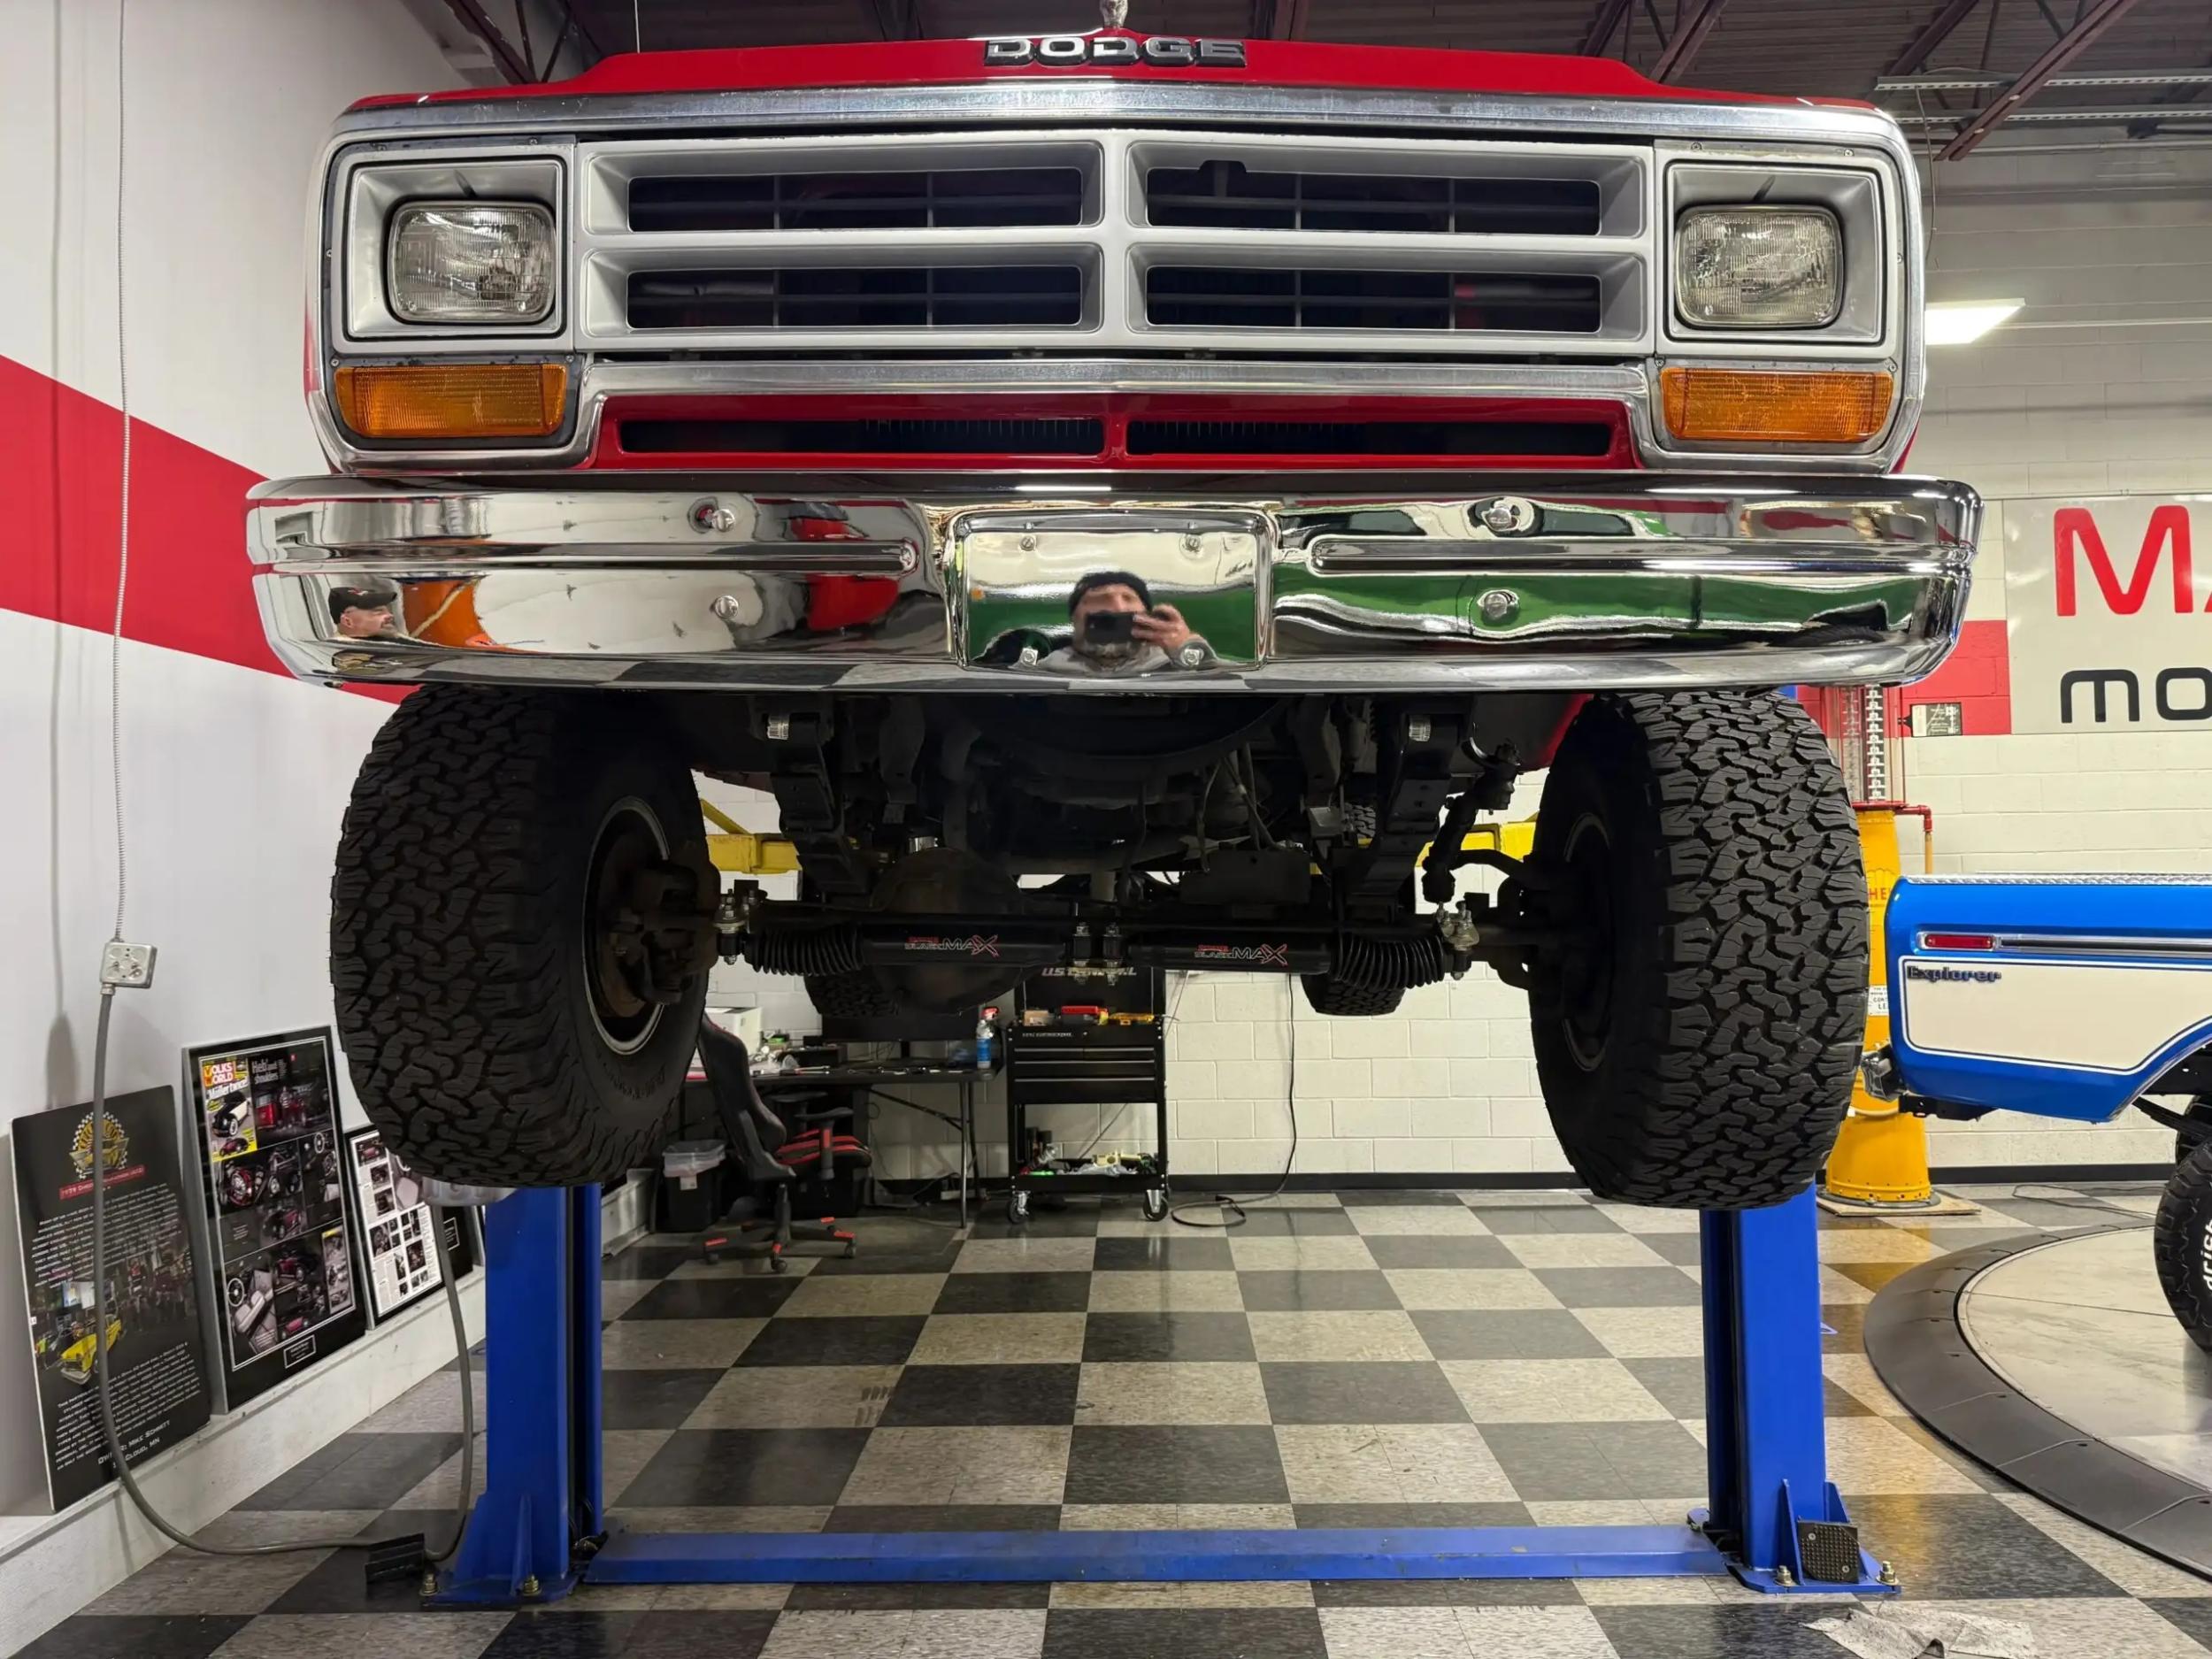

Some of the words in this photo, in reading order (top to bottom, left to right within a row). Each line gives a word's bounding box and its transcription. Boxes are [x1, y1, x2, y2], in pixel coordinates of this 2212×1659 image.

[984, 36, 1247, 67] DODGE
[2054, 505, 2212, 617] M
[1868, 887, 1892, 900] HE
[1907, 965, 2001, 982] Explorer
